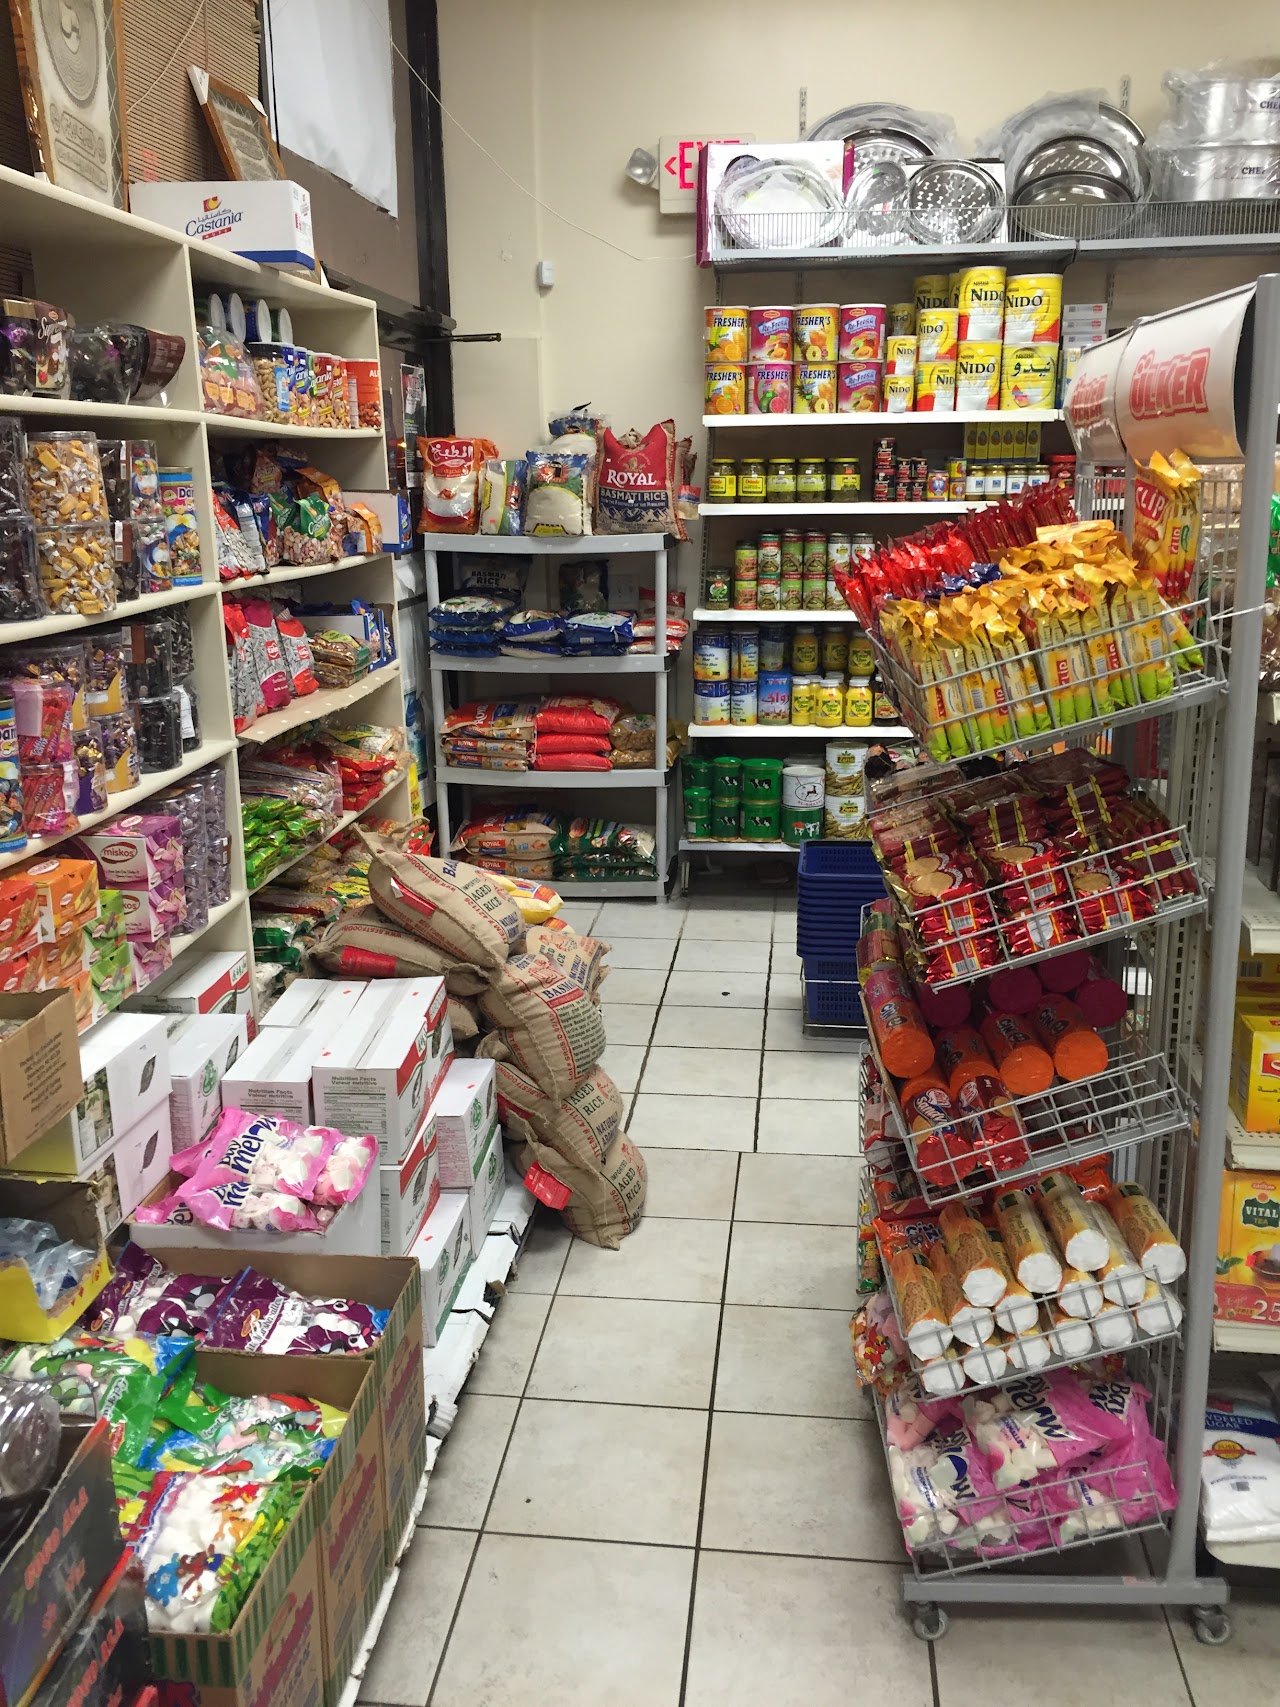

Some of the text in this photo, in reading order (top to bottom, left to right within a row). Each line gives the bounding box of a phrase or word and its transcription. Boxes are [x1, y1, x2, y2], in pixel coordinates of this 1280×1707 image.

[186, 211, 243, 237] Castania
[1006, 295, 1042, 308] NIDO
[706, 371, 743, 381] FRESHER'S
[799, 370, 836, 380] FRESHER'S
[958, 362, 995, 375] NIDO
[1011, 360, 1052, 377] نيدو
[936, 374, 955, 385] NID
[889, 385, 911, 394] NIDO
[606, 469, 657, 488] ROYAL
[600, 489, 667, 501] BASMATI RICE
[1136, 486, 1166, 521] CLIP
[1169, 527, 1181, 554] CLIP
[476, 576, 500, 585] RICE
[103, 847, 136, 857] miskos
[471, 884, 492, 901] AGED
[483, 896, 502, 912] RICE
[494, 924, 508, 944] ITEM
[570, 1082, 595, 1105] AGED
[582, 1095, 605, 1115] RICE
[587, 1136, 601, 1159] ITEM
[617, 1168, 636, 1192] AGED
[625, 1181, 642, 1203] RICE
[1246, 1206, 1279, 1218] VITAL
